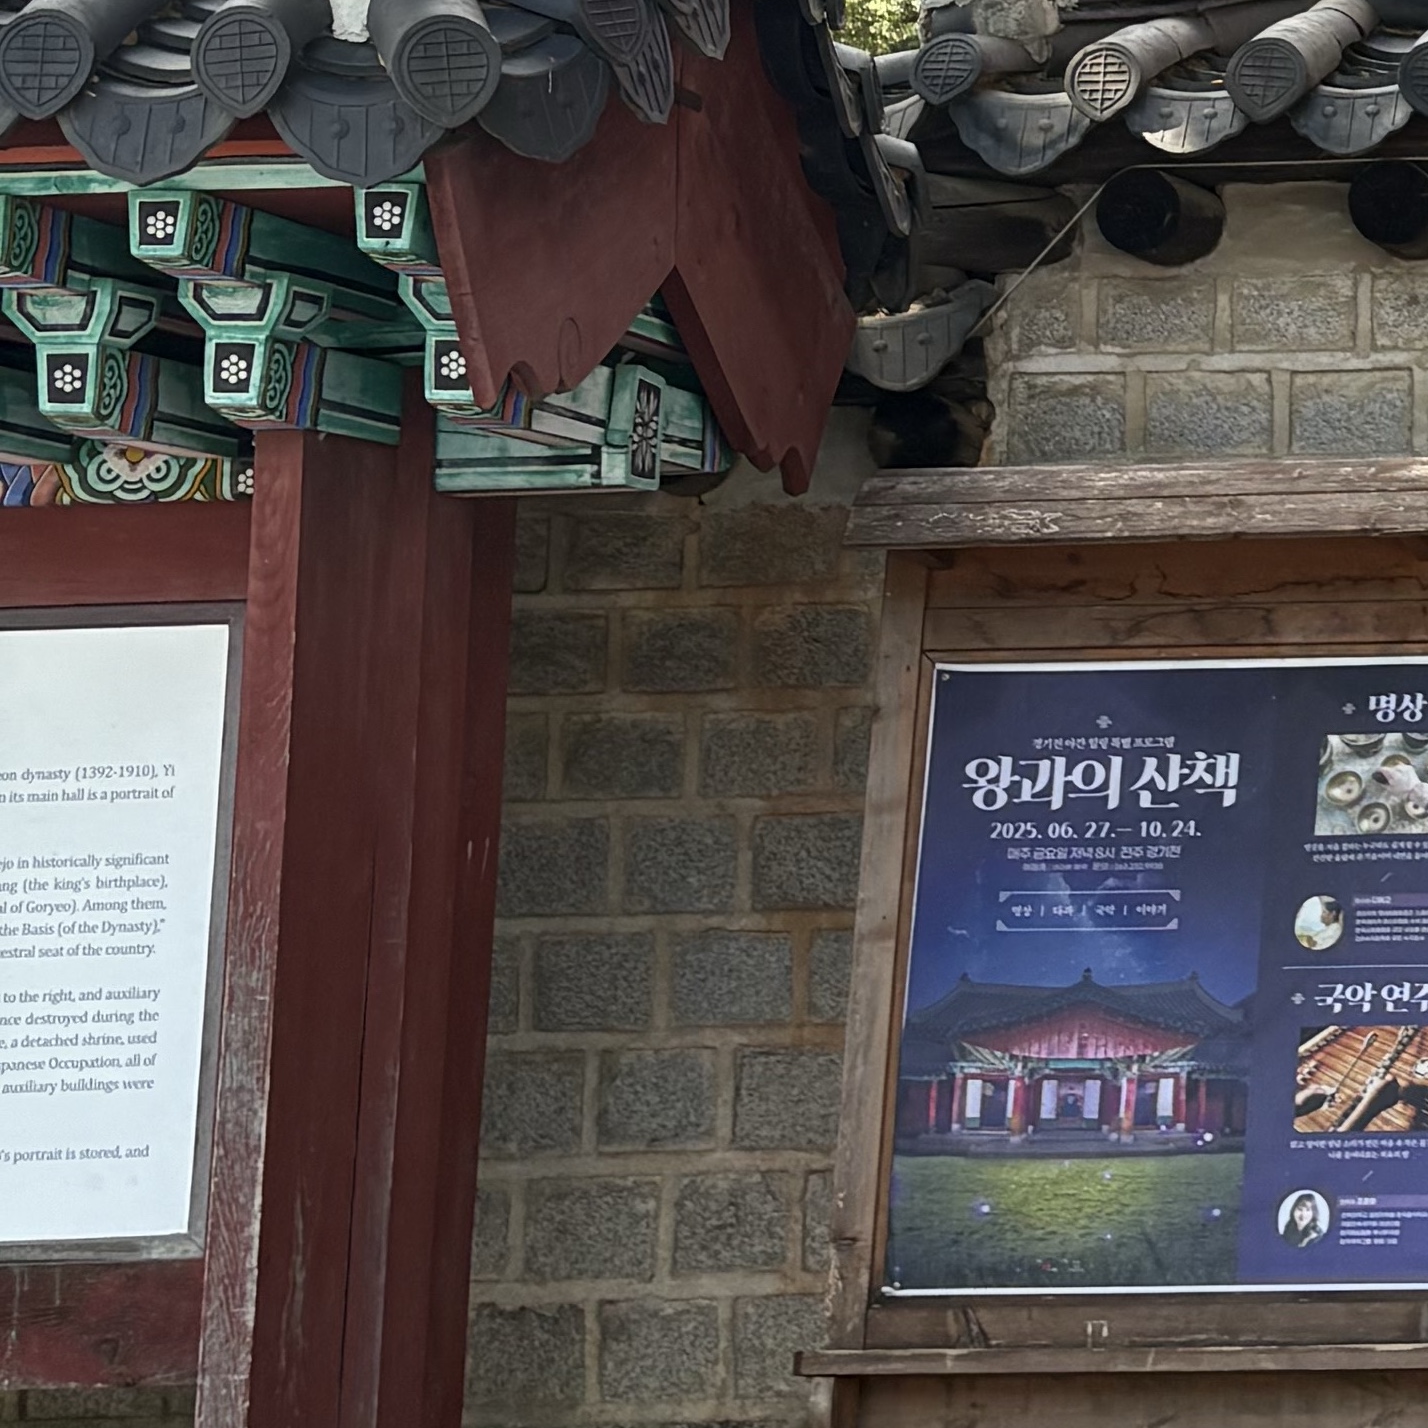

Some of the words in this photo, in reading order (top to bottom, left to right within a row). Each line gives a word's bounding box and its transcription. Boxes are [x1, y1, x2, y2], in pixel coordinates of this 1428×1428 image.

[1369, 693, 1427, 722] 명상
[21, 769, 71, 783] dynasty
[163, 764, 174, 776] Yi
[963, 756, 1122, 810] 왕과의
[1130, 752, 1239, 807] 산책
[9, 791, 24, 803] its
[27, 793, 58, 802] main
[62, 788, 84, 801] hall
[87, 789, 97, 800] is
[100, 791, 107, 800] a
[110, 789, 158, 803] portrait
[162, 786, 175, 798] of
[17, 857, 29, 869] in
[33, 855, 102, 869] historically
[105, 853, 169, 868] significant
[23, 878, 49, 893] (the
[54, 877, 90, 892] king's
[10, 901, 24, 913] of
[82, 899, 127, 913] Among
[22, 923, 54, 935] Basis
[58, 921, 77, 937] (of
[78, 921, 98, 933] the
[38, 947, 63, 957] seat
[67, 944, 81, 956] of
[83, 944, 102, 956] the
[4, 993, 16, 1003] to
[19, 990, 39, 1003] the
[79, 988, 102, 1001] and
[105, 987, 160, 1001] auxiliary
[1315, 983, 1377, 1013] 국악
[25, 1013, 88, 1027] destroyed
[92, 1011, 134, 1025] during
[139, 1009, 159, 1021] the
[11, 1039, 18, 1048] a
[21, 1034, 78, 1047] detached
[128, 1032, 157, 1044] used
[125, 1054, 140, 1067] all
[143, 1053, 157, 1066] of
[2, 1080, 57, 1095] auxiliary
[61, 1079, 119, 1093] buildings
[123, 1080, 154, 1089] were
[13, 1150, 62, 1164] portrait
[66, 1148, 76, 1160] is
[125, 1145, 149, 1157] and
